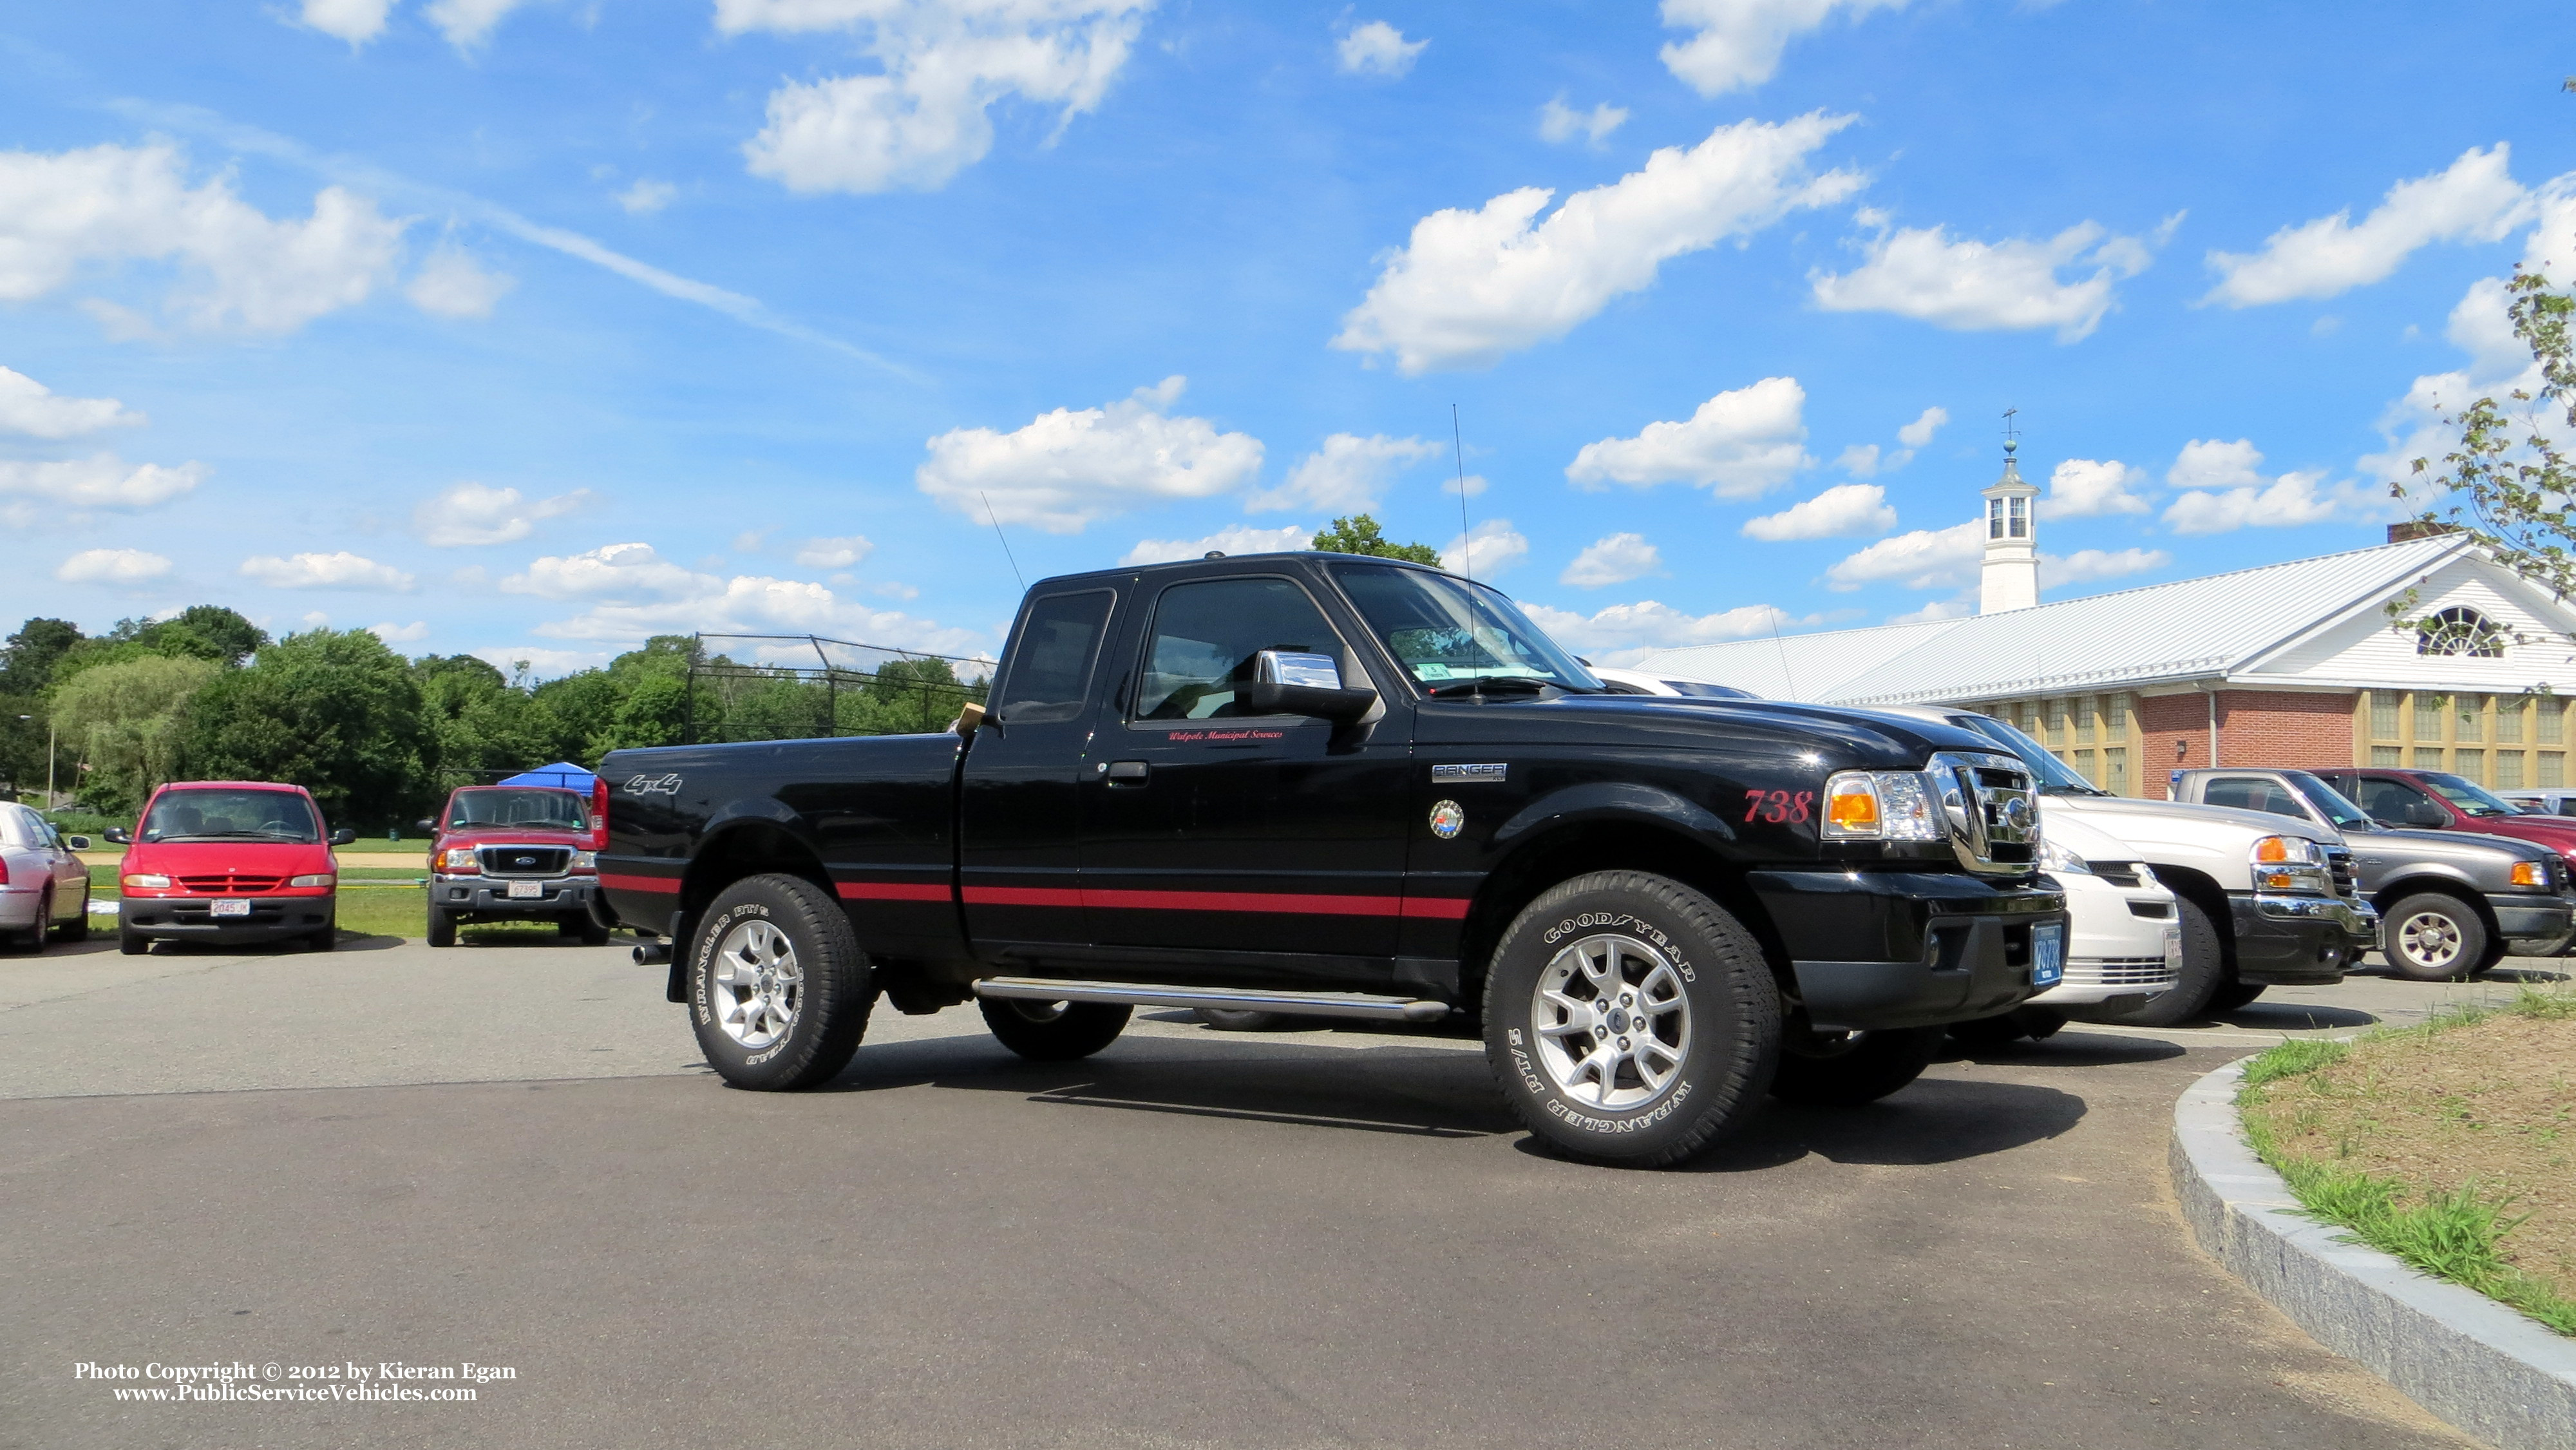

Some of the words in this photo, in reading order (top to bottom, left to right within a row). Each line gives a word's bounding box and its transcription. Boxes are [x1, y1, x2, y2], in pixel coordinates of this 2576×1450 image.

[1169, 732, 1204, 742] Walpole
[1205, 730, 1251, 741] Municipal
[1250, 730, 1283, 739] Services
[623, 773, 683, 796] 4x4
[1434, 765, 1505, 776] RANGER
[1744, 789, 1814, 824] 738
[213, 903, 236, 913] 2045
[696, 913, 731, 1025] WRANGLER
[1508, 1027, 1546, 1094] RT/S
[1546, 1080, 1692, 1134] WRANGLER
